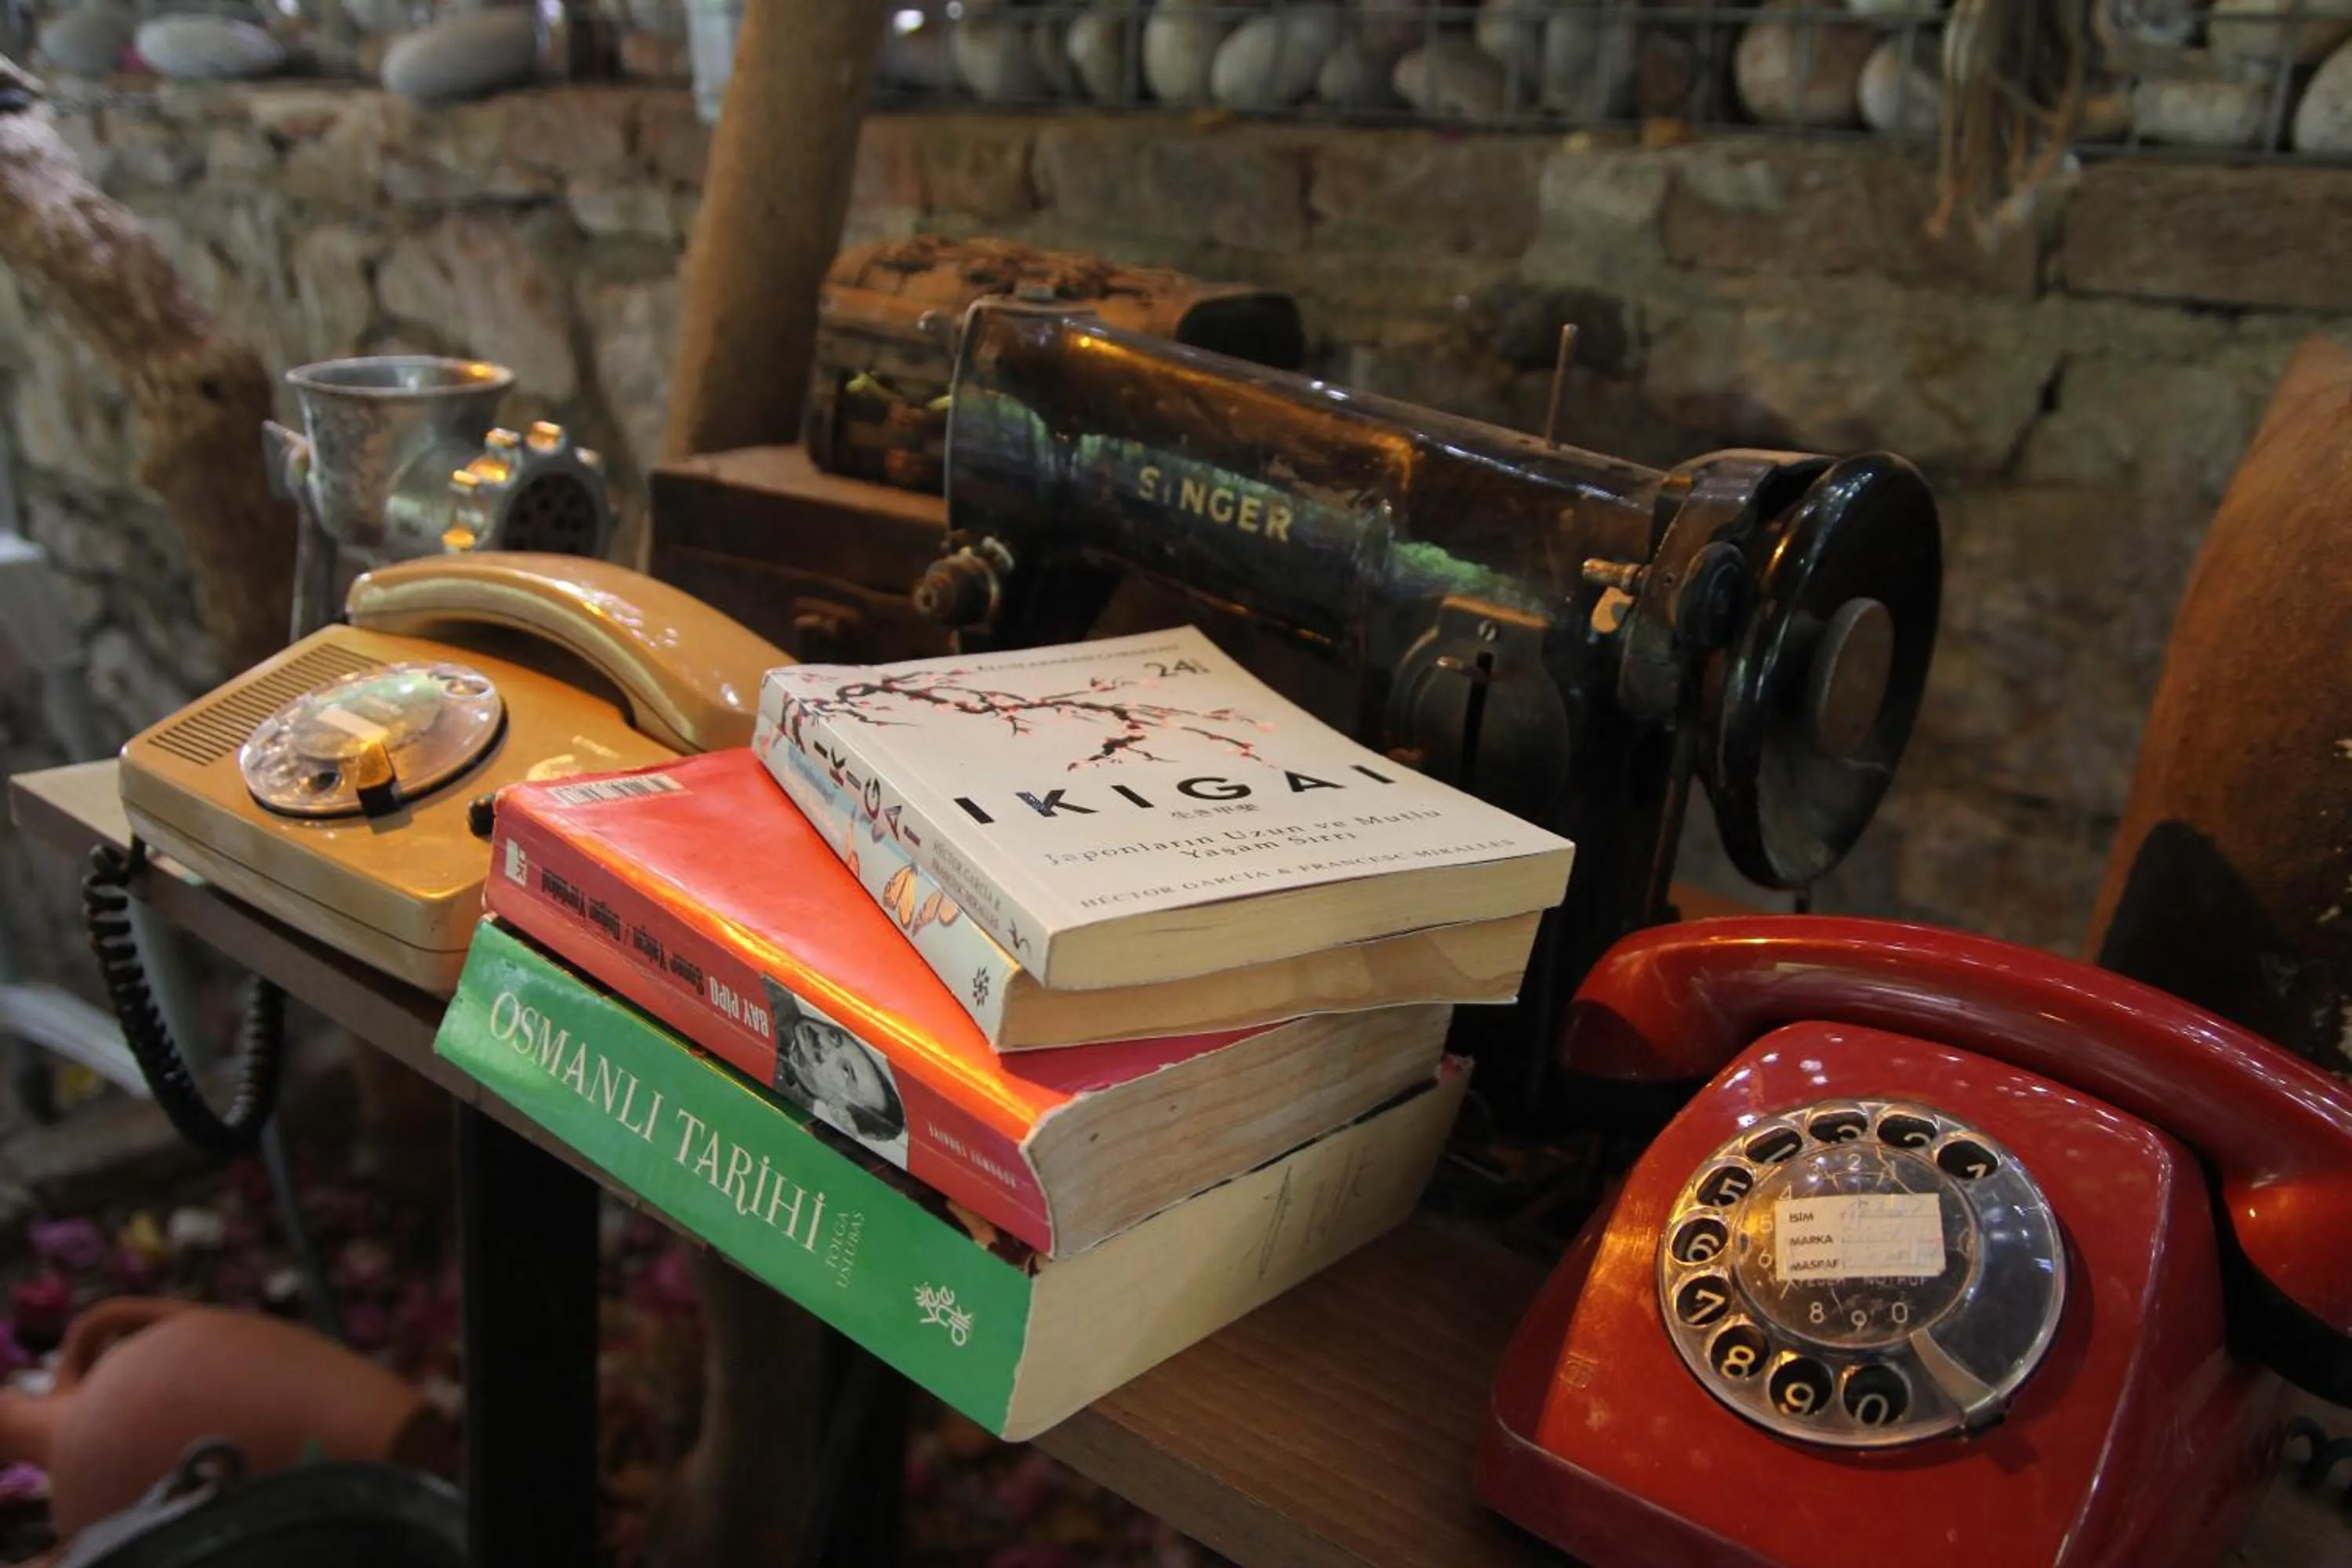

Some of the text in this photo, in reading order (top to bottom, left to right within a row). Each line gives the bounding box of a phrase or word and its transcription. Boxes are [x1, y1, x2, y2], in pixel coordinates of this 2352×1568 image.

[1138, 466, 1294, 543] SINGER
[814, 740, 920, 848] IKIGAI
[953, 764, 1396, 825] IKIGAI
[1045, 808, 1443, 865] Japonların Uzun ve Mutlu
[1179, 840, 1279, 858] Yaşam
[1414, 838, 1516, 858] MIRALLES
[743, 999, 769, 1038] BAY
[490, 992, 665, 1143] OSMANLI
[674, 1108, 826, 1254] TARİHİ
[1847, 1153, 1862, 1171] 2
[1712, 1178, 1748, 1207] 5
[1687, 1233, 1720, 1262] 6
[1789, 1234, 1834, 1247] MARKA
[1687, 1290, 1726, 1324] 7
[1809, 1301, 1825, 1323] 8
[1850, 1309, 1867, 1332] 9
[1892, 1301, 1908, 1324] 0
[1720, 1345, 1756, 1380] 8
[1779, 1381, 1815, 1415] 9
